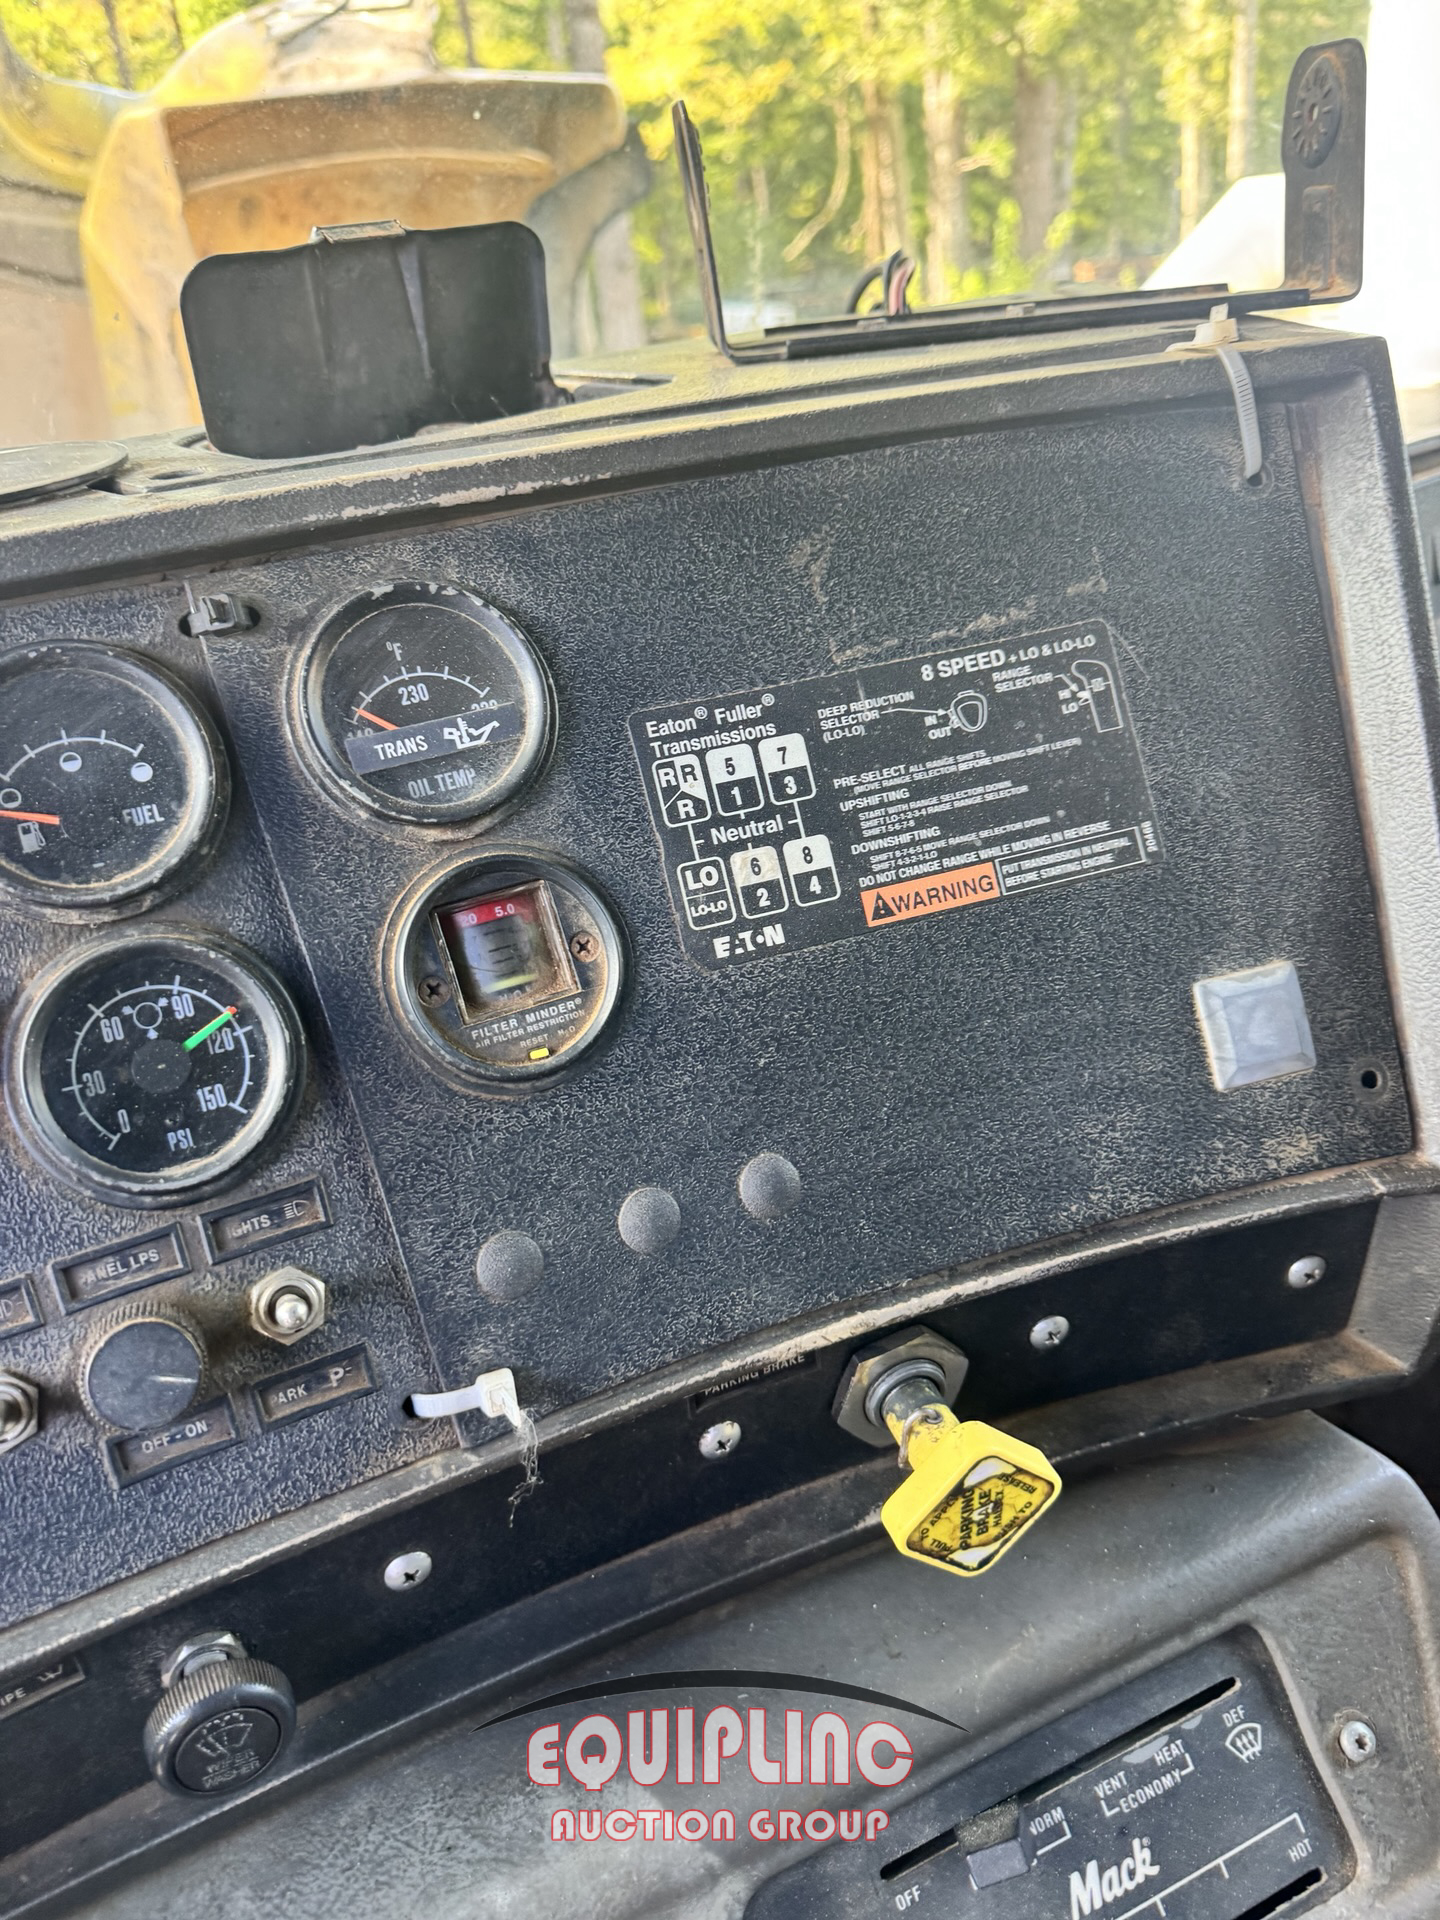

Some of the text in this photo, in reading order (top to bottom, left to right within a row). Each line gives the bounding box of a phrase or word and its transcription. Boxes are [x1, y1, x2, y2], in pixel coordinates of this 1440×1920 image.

[921, 664, 934, 681] 8
[937, 649, 1006, 678] SPEED
[1019, 646, 1040, 661] LO
[1041, 644, 1053, 657] &
[1053, 634, 1096, 654] LO-LO
[992, 665, 1033, 682] RANGE
[994, 672, 1054, 693] SELECTOR
[398, 682, 430, 706] 230
[817, 691, 915, 719] DEEP REDUCTION
[820, 709, 880, 731] SELECTOR
[1061, 702, 1079, 715] LO
[924, 714, 938, 727] IN
[650, 723, 776, 758] Transmissions
[823, 724, 865, 744] (LO-LO)
[928, 726, 952, 740] OUT
[374, 735, 428, 760] TRANS
[777, 746, 787, 765] 7
[680, 764, 698, 783] R
[724, 757, 735, 775] 5
[833, 764, 906, 789] PRE-SELECT
[909, 763, 925, 773] ALL
[407, 767, 477, 799] OIL TEMP
[658, 768, 677, 788] R
[784, 776, 797, 795] 3
[731, 786, 743, 806] 1
[839, 788, 910, 812] UPSHIFTING
[858, 808, 886, 821] START
[887, 803, 909, 814] WITH
[909, 796, 940, 809] RANGE
[940, 786, 984, 802] SELECTOR
[122, 803, 165, 826] FUEL
[677, 799, 696, 819] R
[860, 817, 885, 829] SHIFT
[885, 808, 927, 824] LO-1-2-3-4
[710, 814, 784, 845] Neutral
[862, 819, 915, 837] SHIFT 5-6-7-8
[851, 826, 941, 855] DOWNSHIFTING
[802, 846, 813, 864] 8
[859, 820, 1112, 888] DO NOT CHANGE RANGE WHILE MOVING IN REVERSE
[870, 851, 894, 864] SHIFT
[685, 865, 719, 890] LO
[750, 857, 762, 875] 6
[872, 860, 896, 872] SHIFT
[1001, 863, 1021, 875] PUT
[1004, 870, 1041, 888] BEFORE
[1040, 861, 1082, 880] STARTING
[809, 876, 822, 894] 4
[891, 874, 995, 913] WARNING
[691, 900, 728, 917] LO-LO
[756, 888, 771, 907] 2
[495, 903, 515, 917] 5.0
[171, 993, 195, 1020] 90
[101, 1016, 125, 1043] 60
[471, 1018, 519, 1041] FILTER
[475, 1009, 585, 1049] AIR FILTER RESTRICTION
[520, 1033, 549, 1048] RESET
[206, 1027, 234, 1055] 120
[82, 1070, 106, 1097] 30
[196, 1083, 228, 1113] 150
[117, 1108, 131, 1134] 0
[167, 1128, 194, 1151] PSI
[129, 1249, 159, 1269] LPS
[141, 1435, 171, 1454] OFF
[185, 1419, 208, 1439] ON
[959, 1488, 975, 1550] PARKING
[976, 1489, 992, 1536] BRAKE
[1018, 1501, 1033, 1514] TO
[0, 1687, 27, 1706] IPE
[1222, 1704, 1246, 1728] DEF
[1153, 1739, 1185, 1767] HEAT
[1094, 1771, 1128, 1799] VENT
[1119, 1768, 1183, 1813] ECONOMY
[1288, 1838, 1313, 1863] HOT
[894, 1884, 921, 1911] OFF
